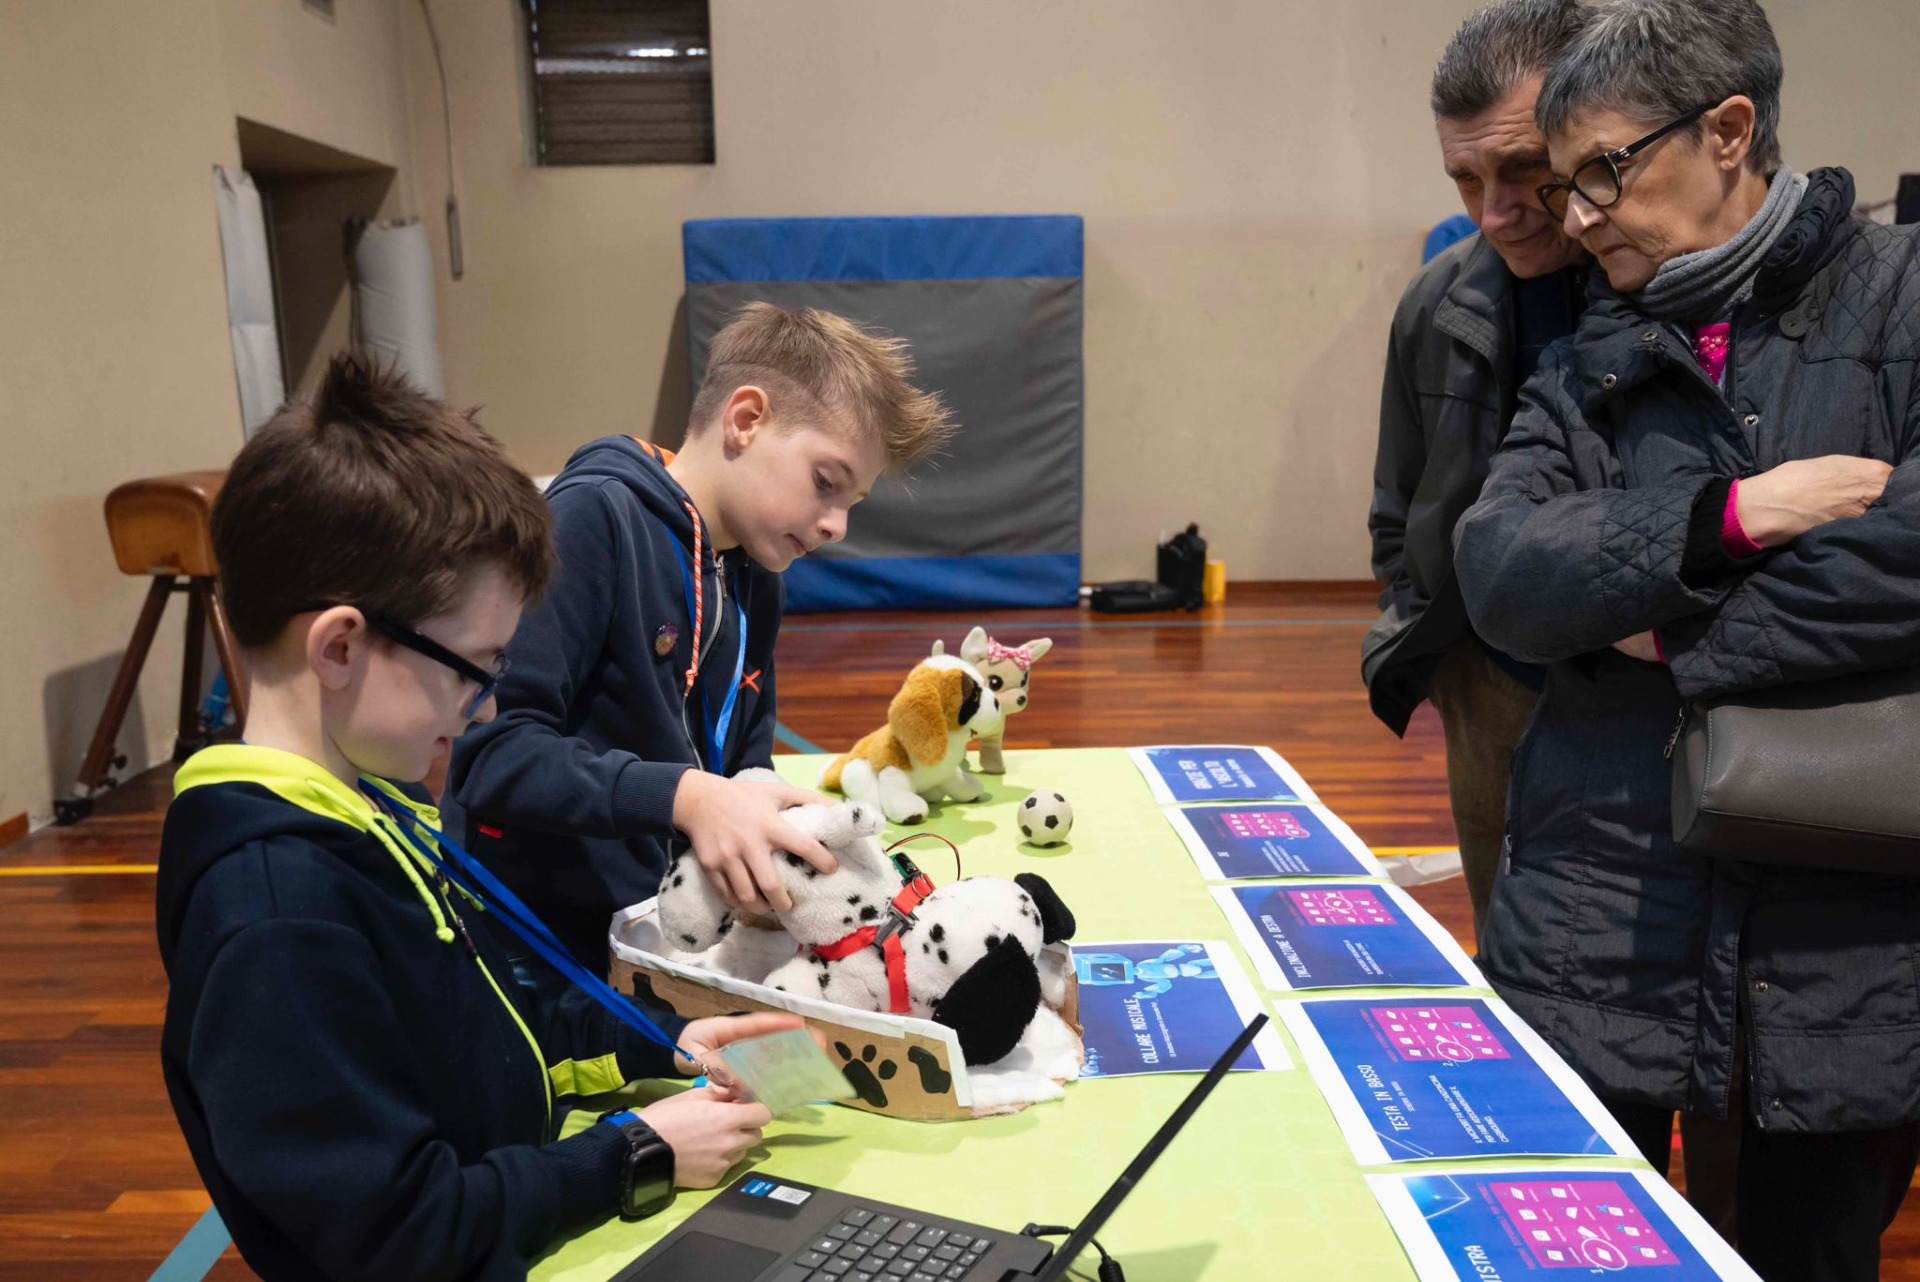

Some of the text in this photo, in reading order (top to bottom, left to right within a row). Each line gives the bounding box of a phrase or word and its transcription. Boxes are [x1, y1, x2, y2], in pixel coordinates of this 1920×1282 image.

[1260, 914, 1282, 933] DESTRA
[1275, 940, 1312, 978] INCLINAZIONE
[1124, 998, 1160, 1064] COLLARE MUSICALE
[1357, 1064, 1384, 1088] BASSO
[1373, 1091, 1392, 1102] IN
[1382, 1105, 1410, 1132] TESTA
[1464, 1244, 1502, 1282] ISTRA
